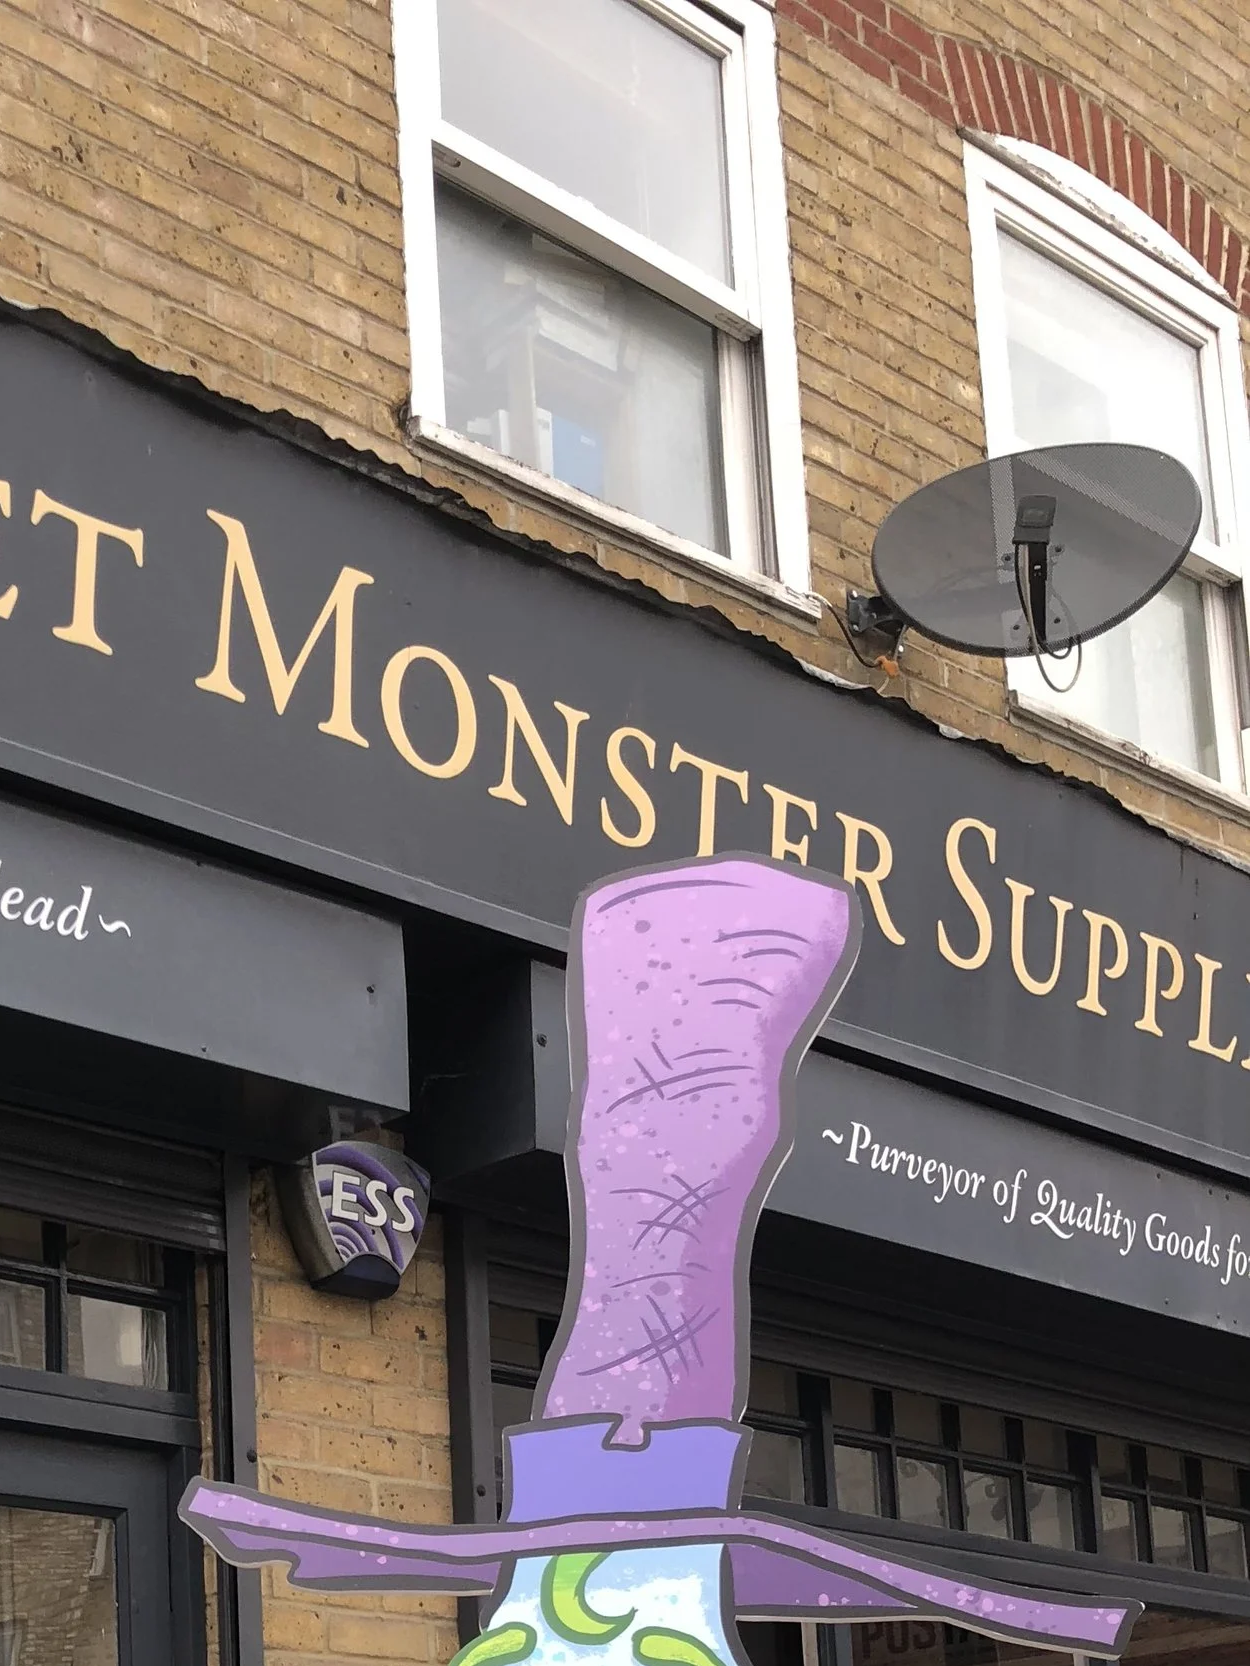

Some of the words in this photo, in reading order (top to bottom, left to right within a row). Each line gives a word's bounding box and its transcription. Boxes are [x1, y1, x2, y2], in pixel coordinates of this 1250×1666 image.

[195, 508, 905, 946] MONSTER
[937, 817, 1250, 1071] SUPPL
[332, 1172, 415, 1233] ESS
[993, 1168, 1027, 1223] of
[1030, 1179, 1137, 1256] Quality
[1144, 1213, 1220, 1267] Goods
[1221, 1234, 1250, 1285] fo
